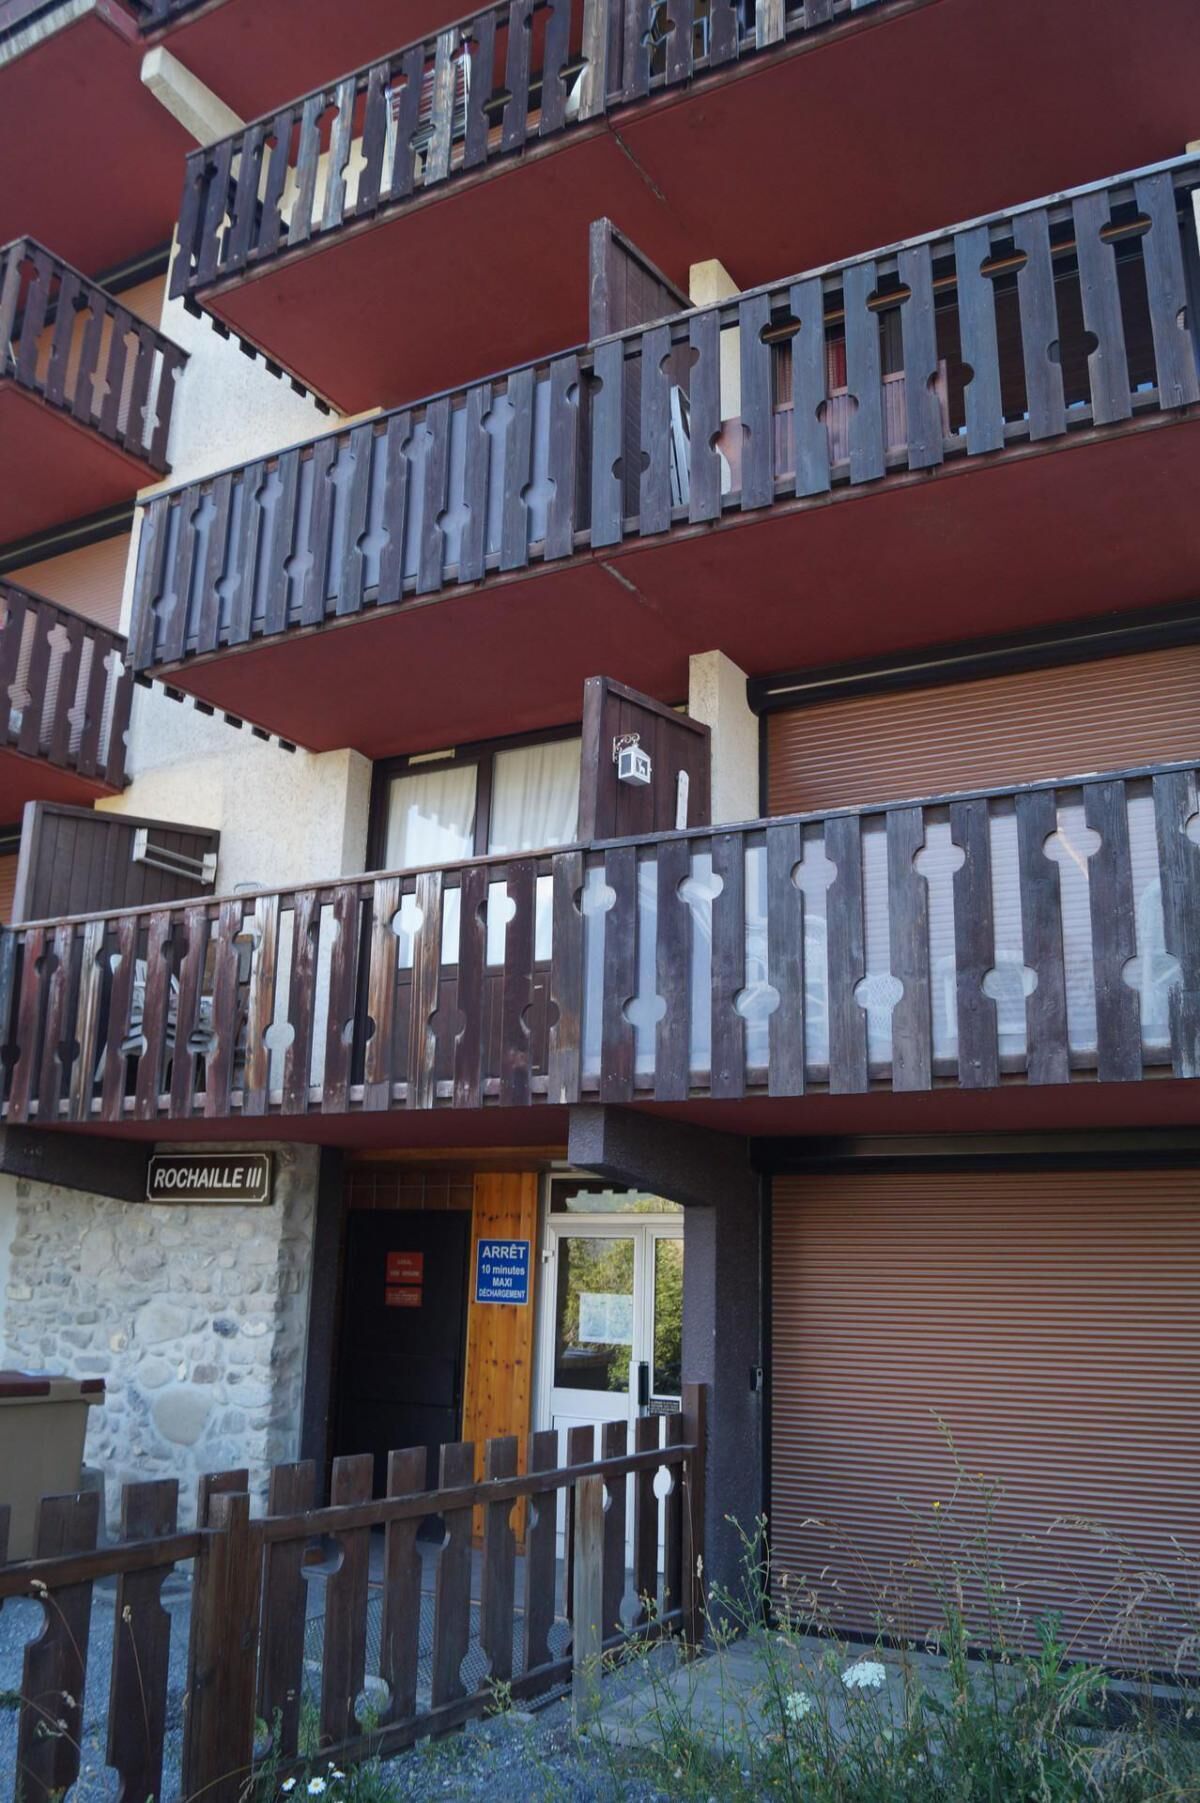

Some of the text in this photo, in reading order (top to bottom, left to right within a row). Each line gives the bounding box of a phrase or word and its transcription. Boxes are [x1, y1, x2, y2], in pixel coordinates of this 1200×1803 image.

[154, 1167, 262, 1188] ROCHAILLE III
[482, 1243, 526, 1259] ARRÊT
[481, 1264, 525, 1275] 10 minutes
[493, 1277, 512, 1287] MAXI
[479, 1287, 525, 1298] DÉCHARGEMENT
